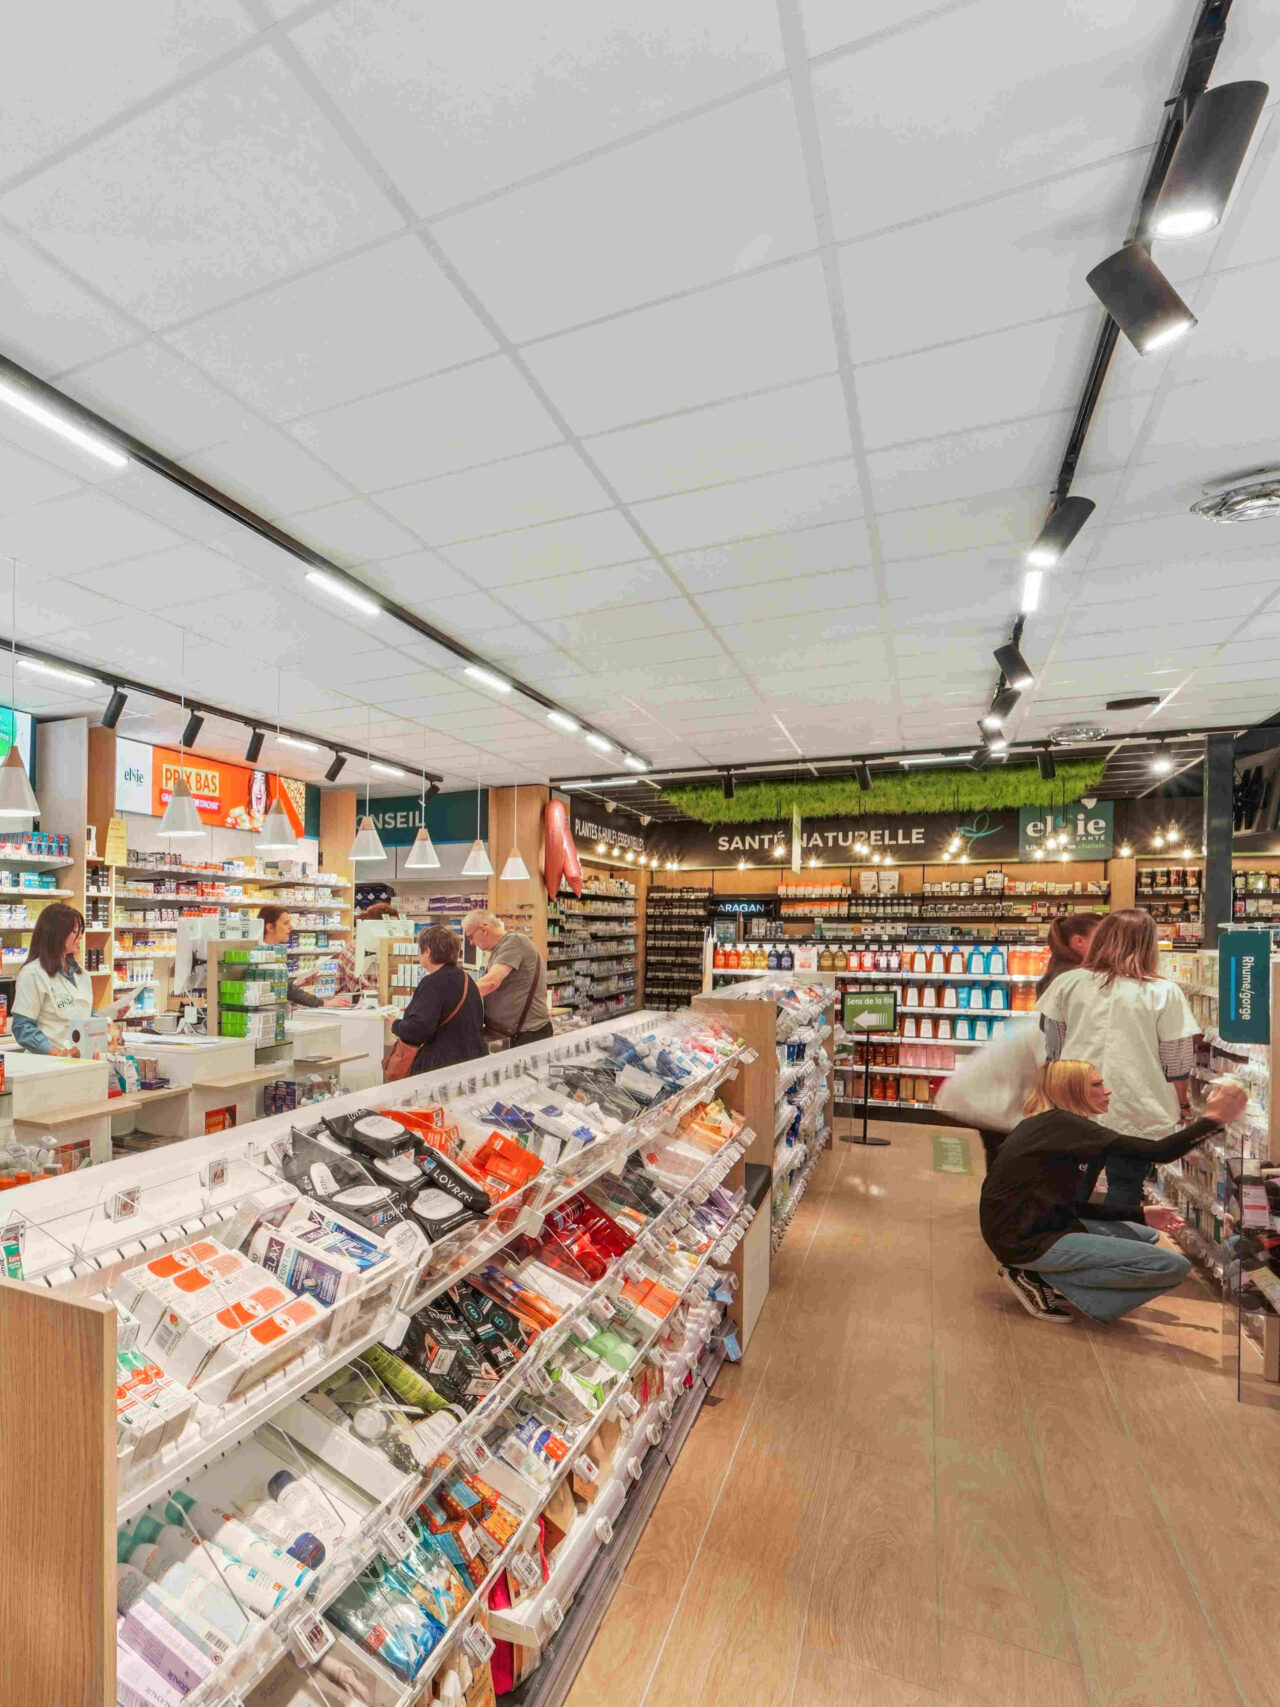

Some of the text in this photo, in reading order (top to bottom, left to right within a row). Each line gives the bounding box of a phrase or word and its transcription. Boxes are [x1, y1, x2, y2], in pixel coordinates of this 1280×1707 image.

[195, 773, 218, 793] BAS
[575, 818, 598, 840] PLANTES
[1238, 955, 1255, 1021] Rhume/gorge
[846, 996, 863, 1006] Sens
[864, 997, 874, 1005] de
[432, 1169, 474, 1205] LOVREN
